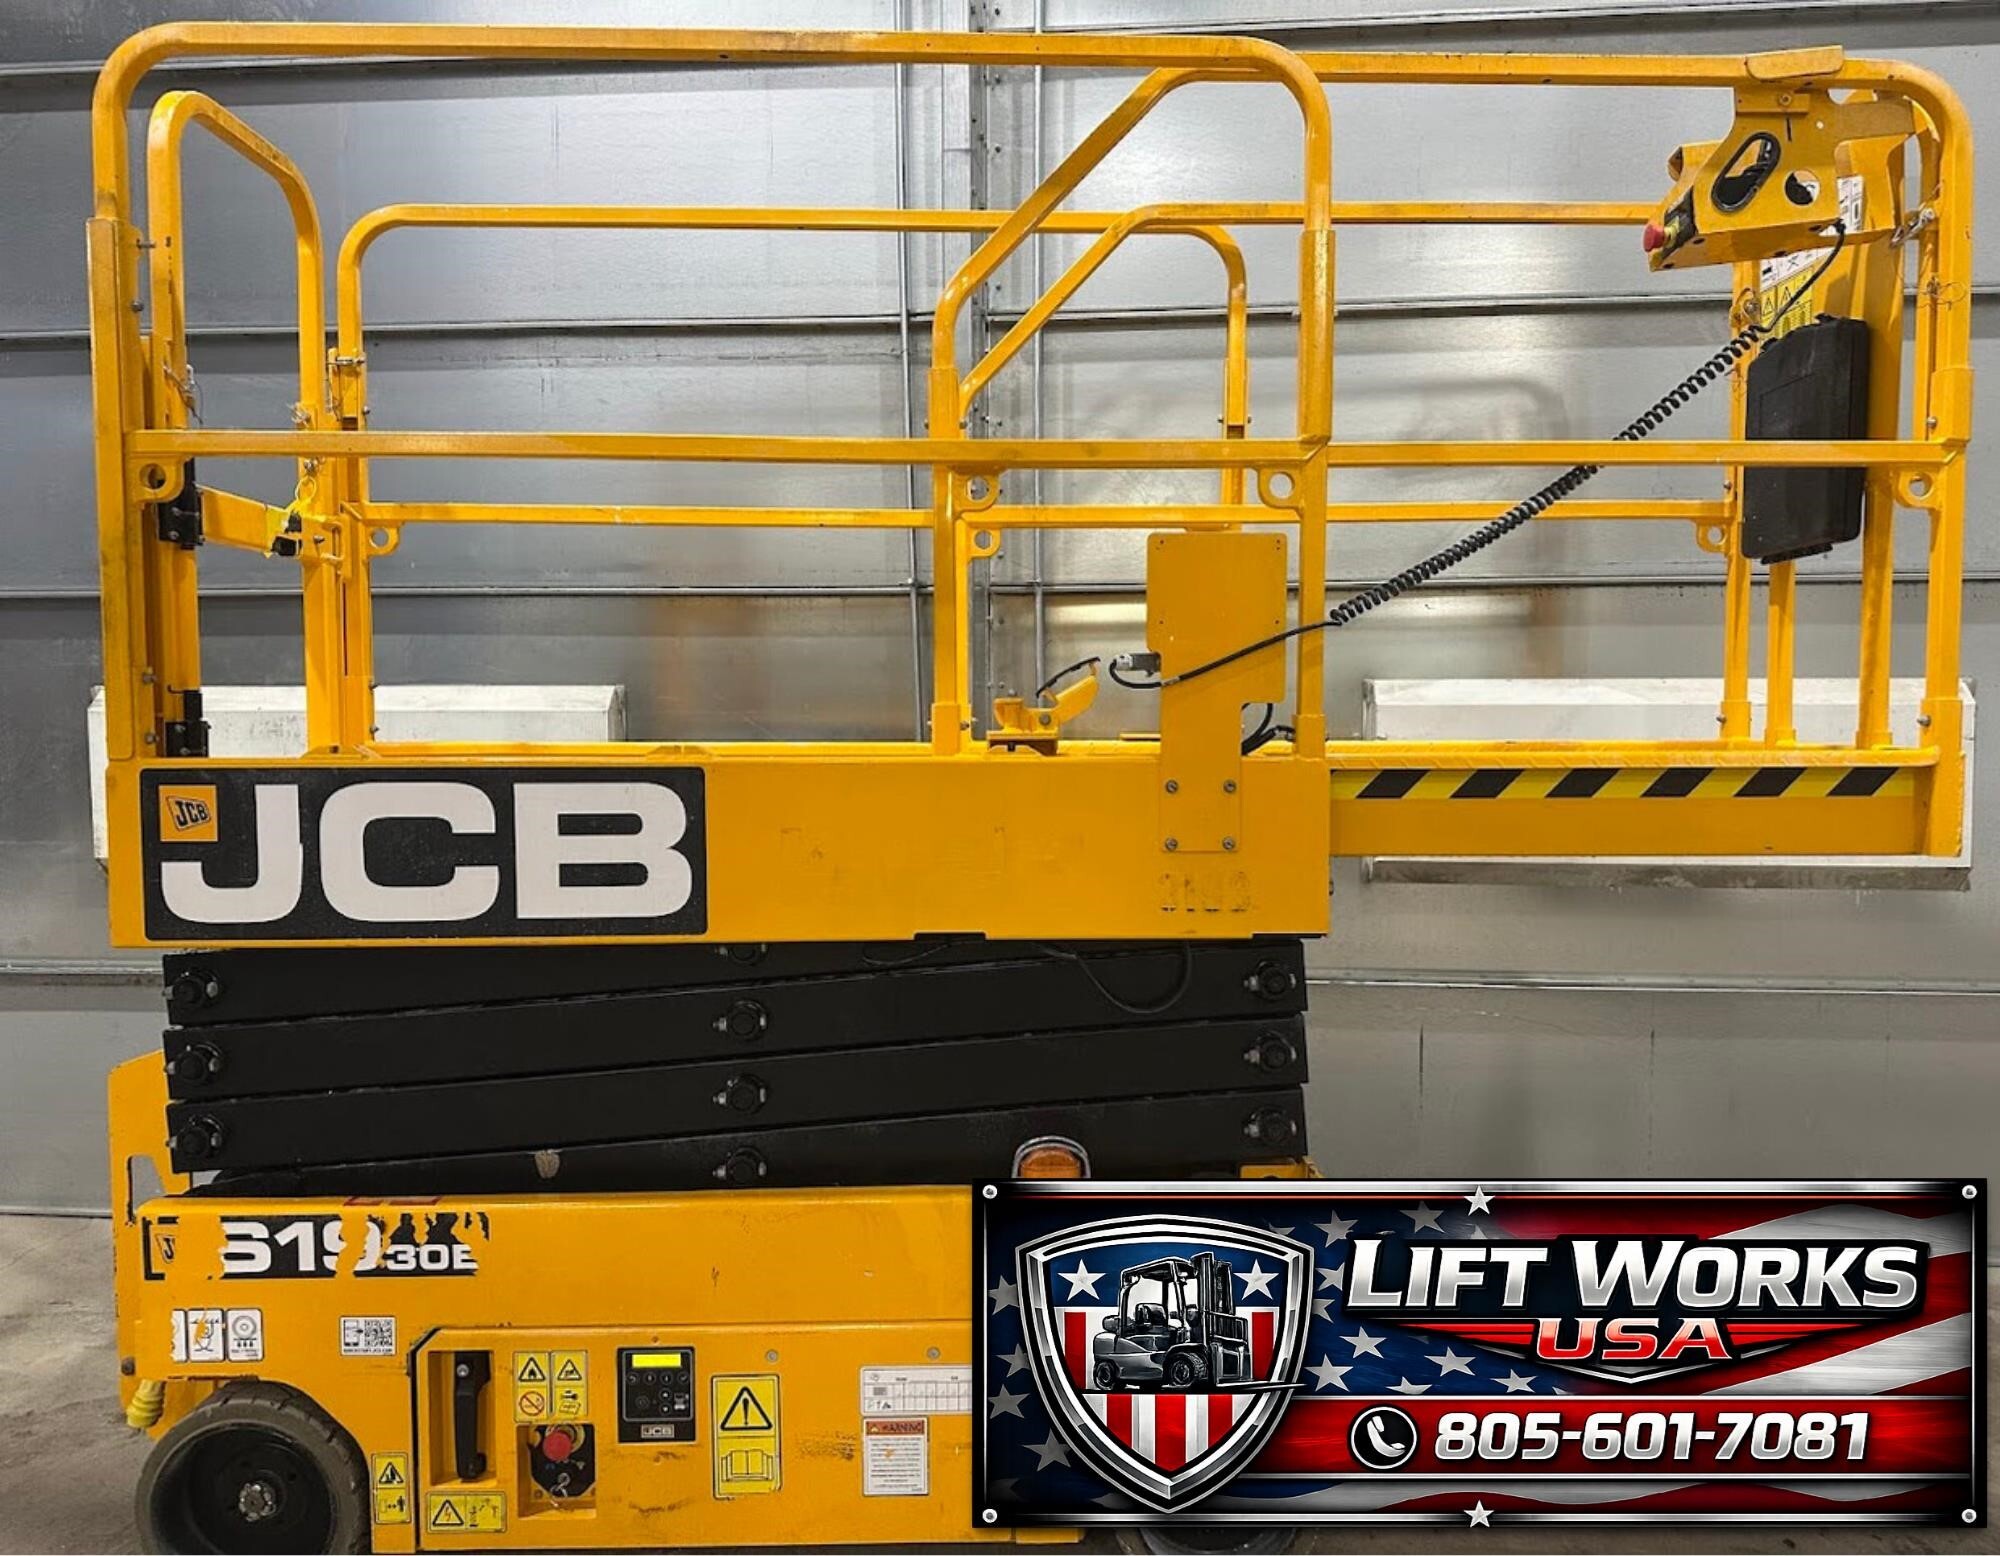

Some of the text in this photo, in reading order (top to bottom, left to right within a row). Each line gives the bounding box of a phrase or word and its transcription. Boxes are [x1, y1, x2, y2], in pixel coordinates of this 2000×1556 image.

[174, 799, 208, 827] JCB
[160, 781, 693, 924] JCB
[643, 1426, 673, 1436] JCB
